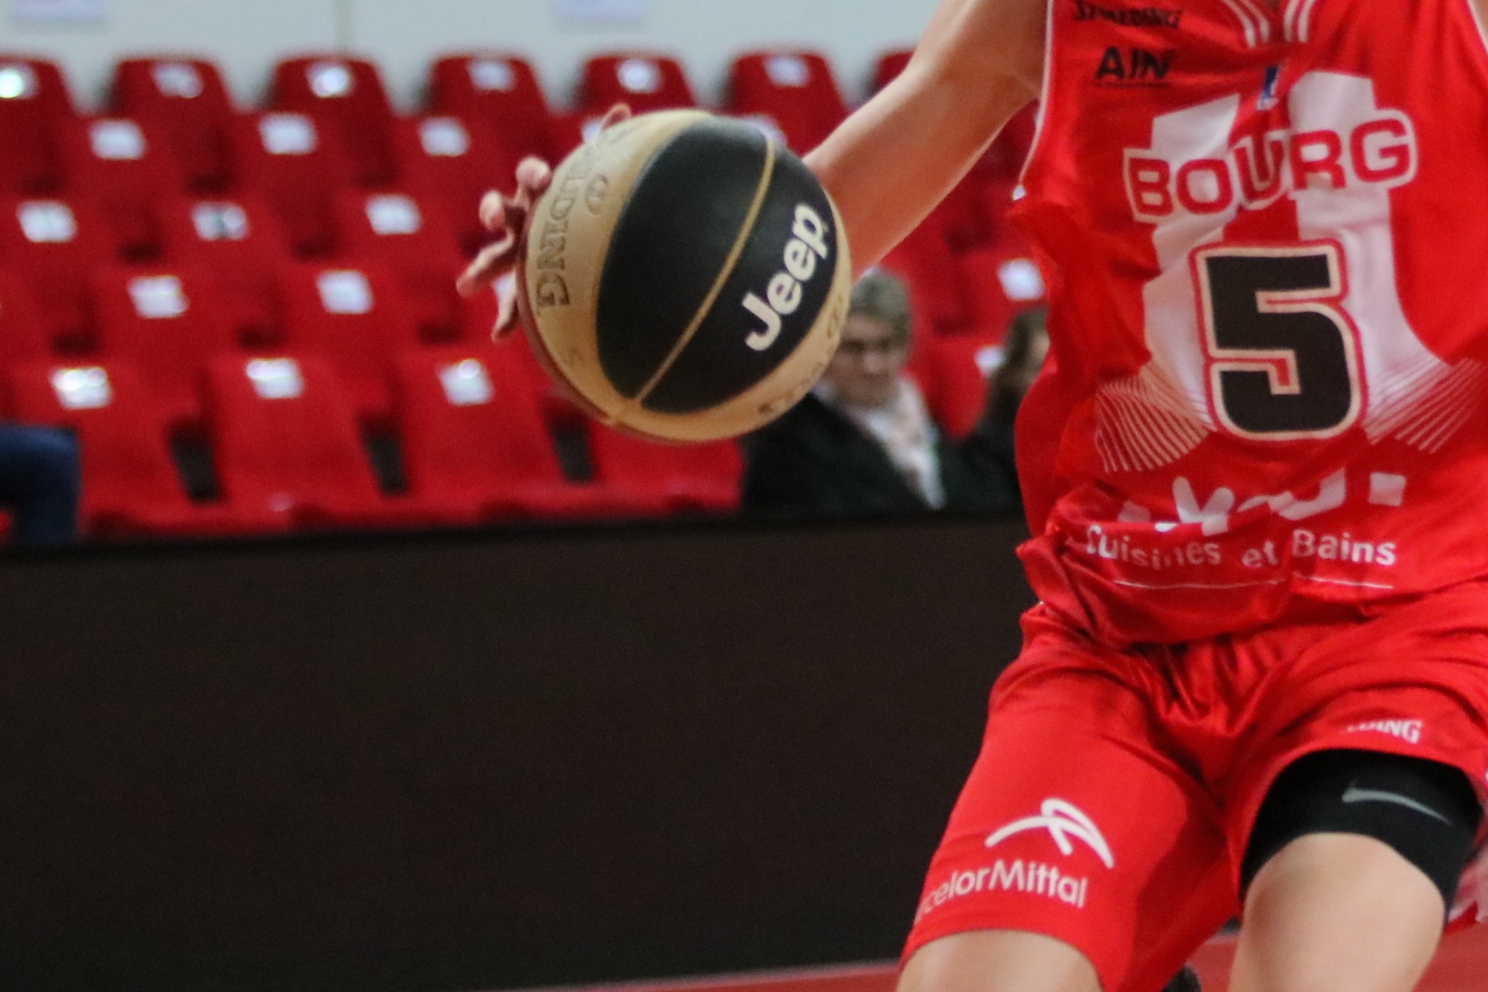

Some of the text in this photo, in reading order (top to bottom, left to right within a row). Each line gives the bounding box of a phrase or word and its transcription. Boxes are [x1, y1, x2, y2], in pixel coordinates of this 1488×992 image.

[1094, 45, 1177, 80] AIN
[1125, 115, 1415, 221] BOURG
[741, 203, 828, 351] Jeep
[1197, 246, 1361, 440] 5
[1241, 539, 1280, 569] et
[1292, 529, 1397, 567] Bains
